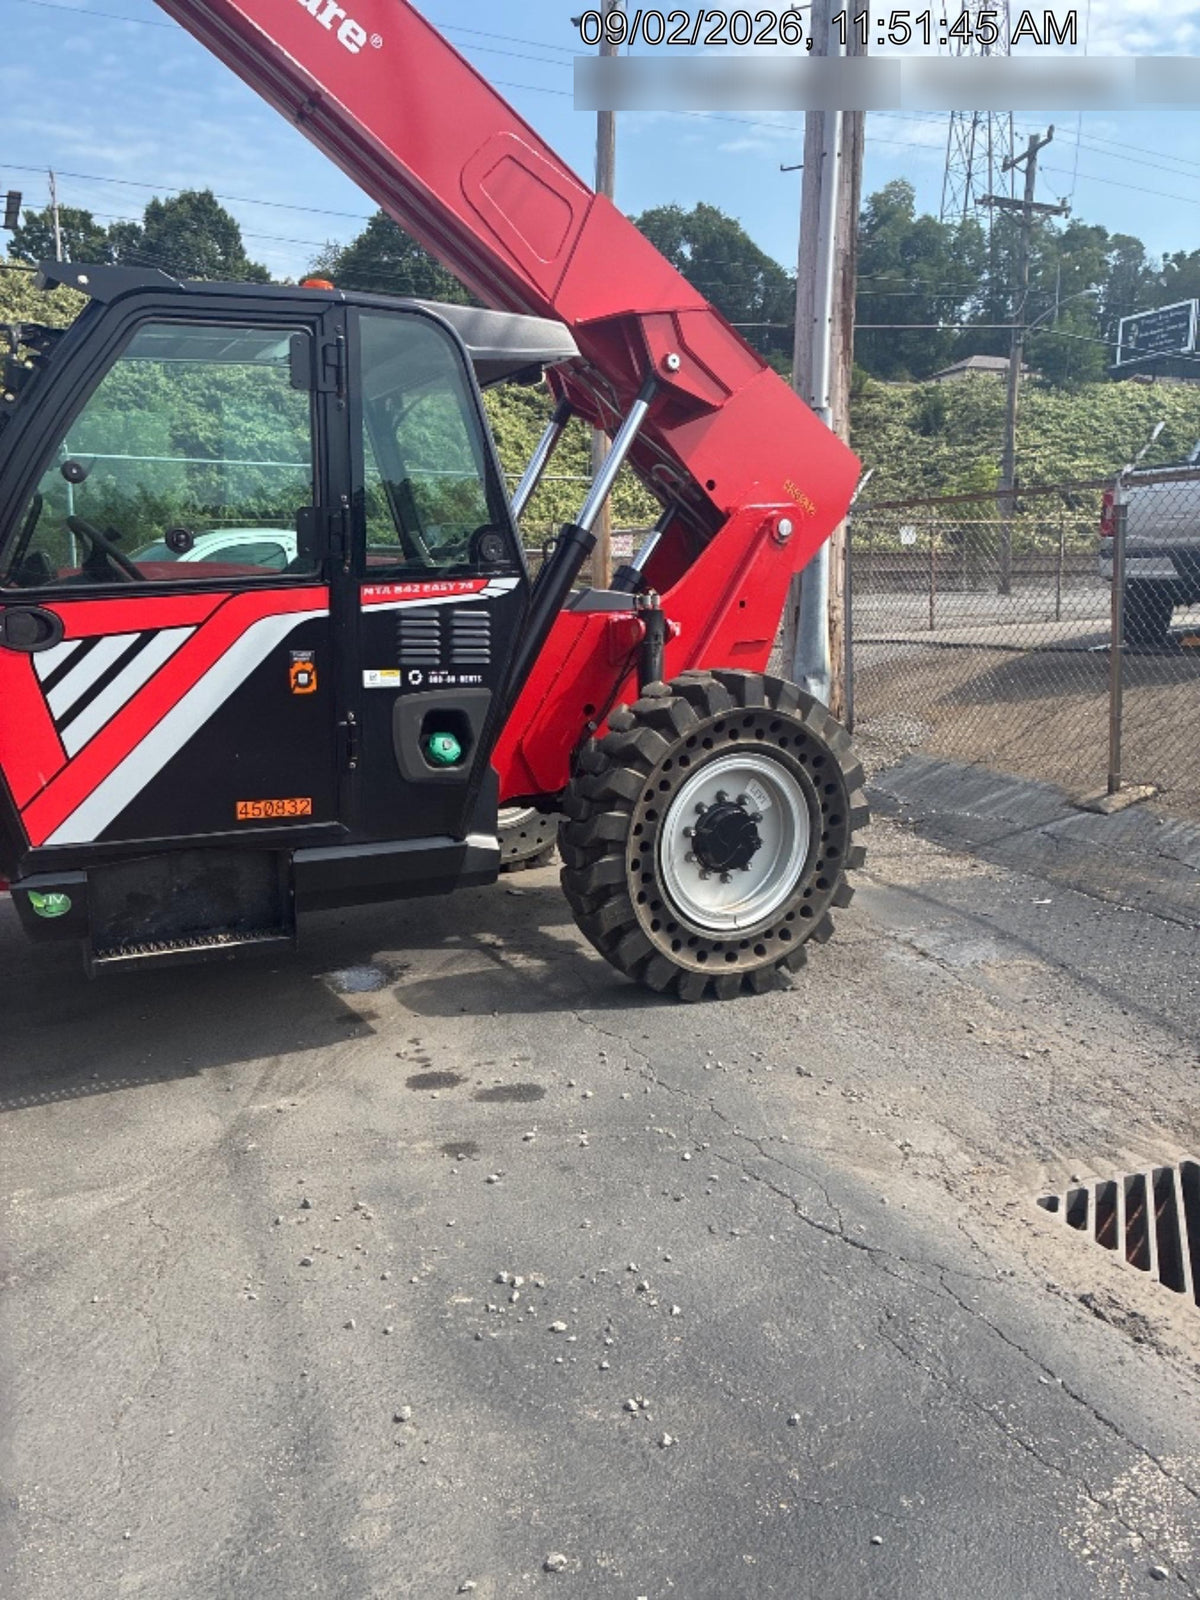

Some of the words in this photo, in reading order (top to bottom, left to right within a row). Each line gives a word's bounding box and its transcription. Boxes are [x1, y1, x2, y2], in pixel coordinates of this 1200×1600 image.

[394, 585, 420, 594] 842
[423, 582, 455, 592] EASY
[239, 800, 310, 818] 450832
